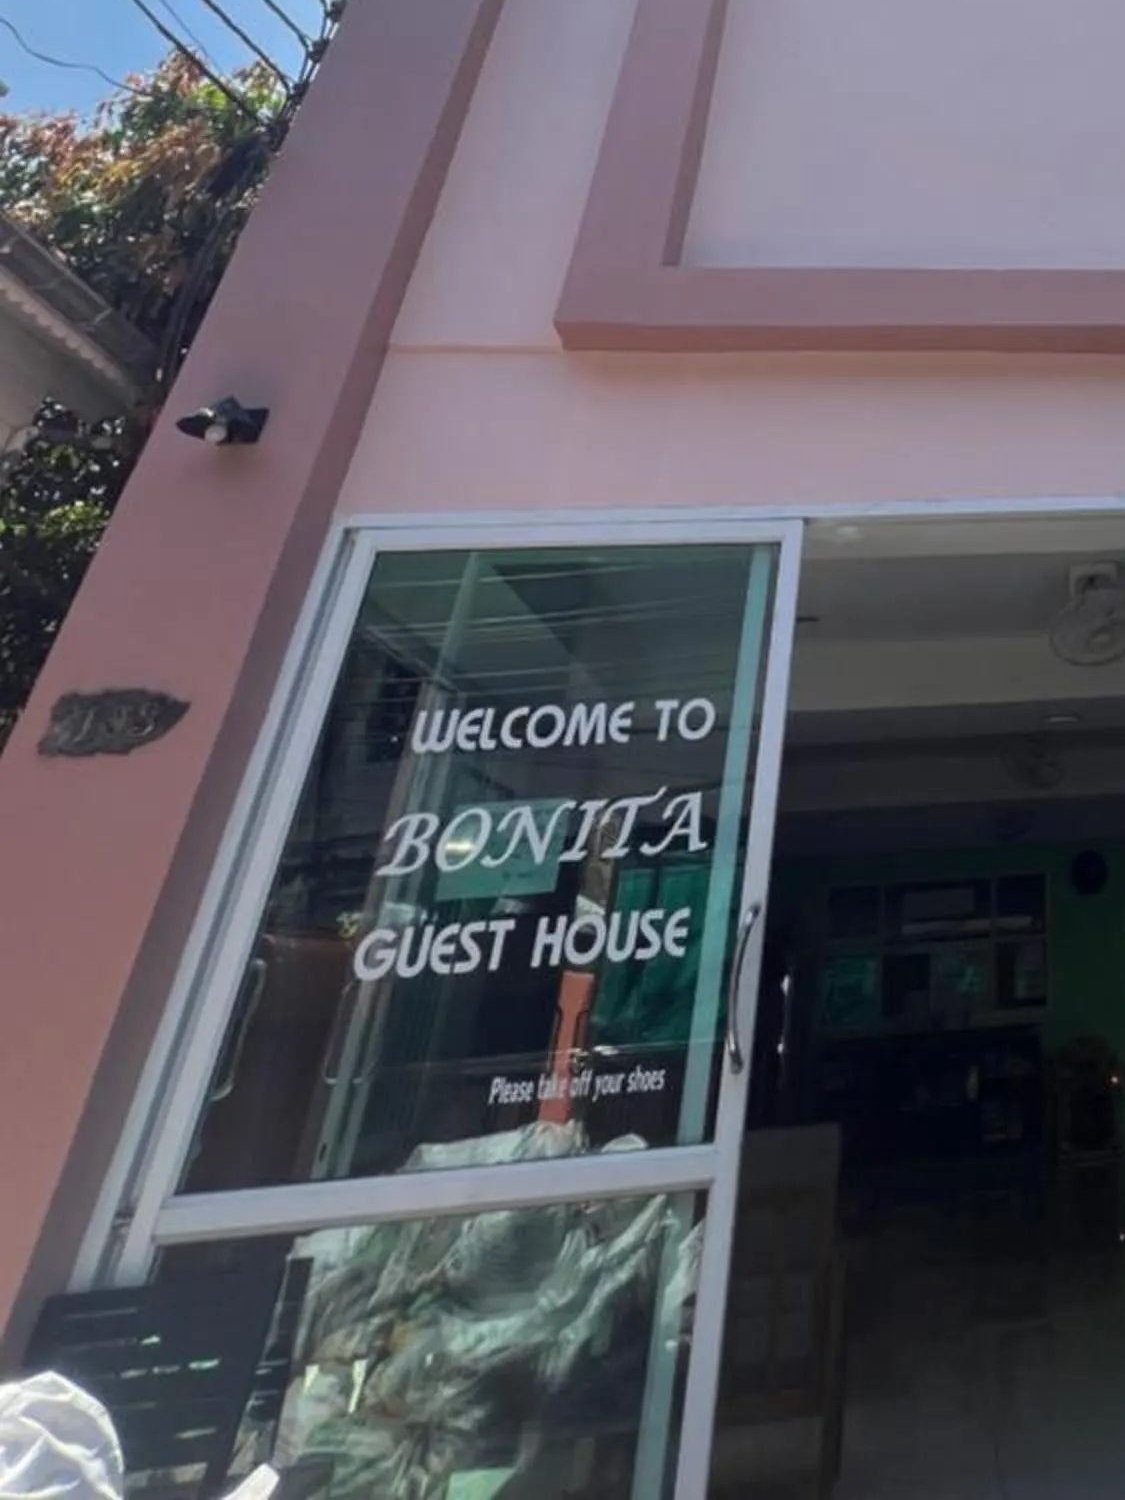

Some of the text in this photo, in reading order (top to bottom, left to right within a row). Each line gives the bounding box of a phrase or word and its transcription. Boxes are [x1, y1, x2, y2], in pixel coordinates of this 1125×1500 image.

[411, 699, 716, 754] WELCOME TO
[374, 786, 709, 877] BONITA
[353, 909, 690, 982] GUEST HOUSE
[488, 1076, 534, 1105] Please
[570, 1070, 594, 1097] off
[593, 1072, 624, 1102] your
[626, 1065, 666, 1093] shoes
